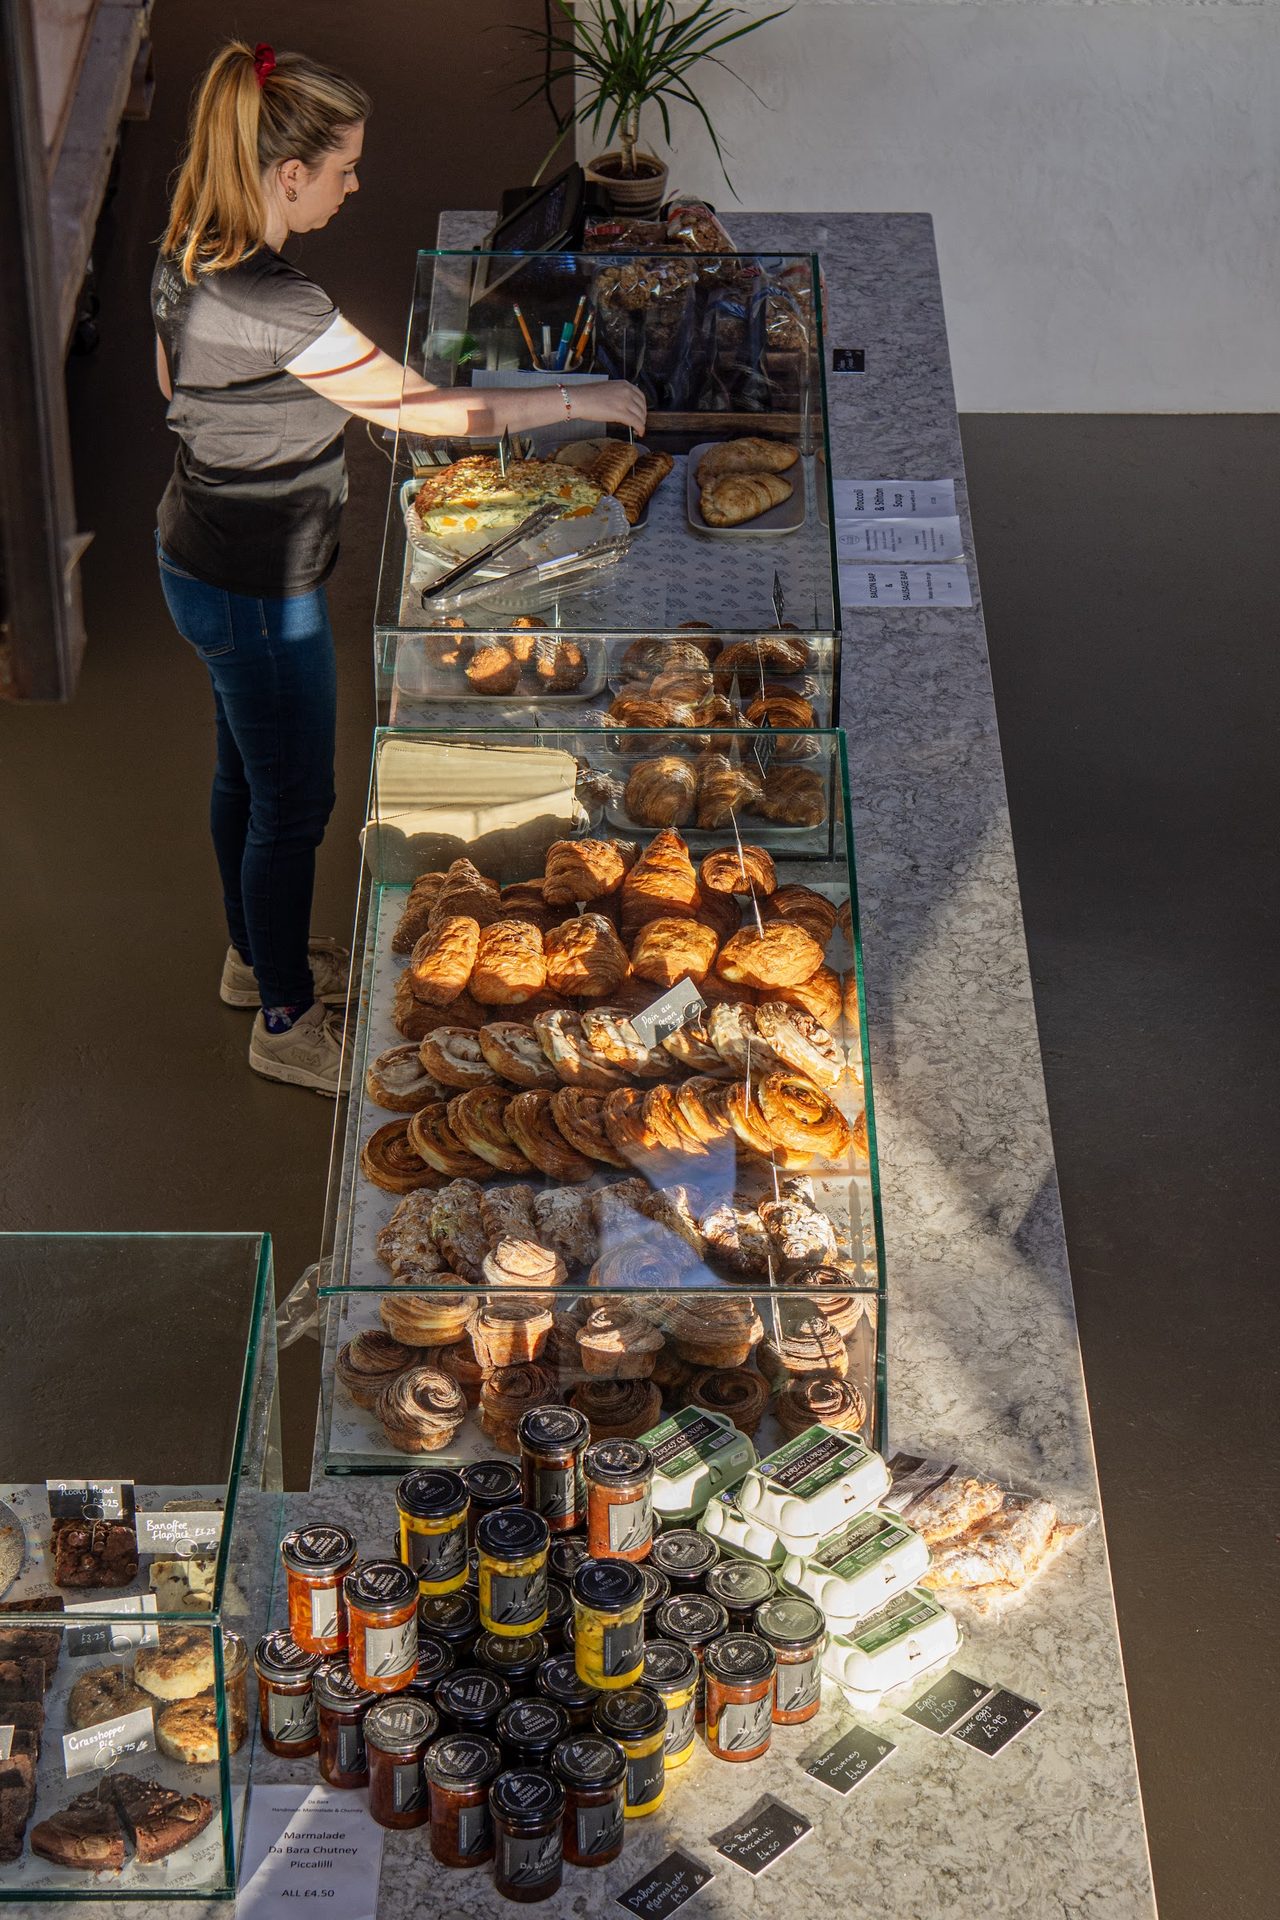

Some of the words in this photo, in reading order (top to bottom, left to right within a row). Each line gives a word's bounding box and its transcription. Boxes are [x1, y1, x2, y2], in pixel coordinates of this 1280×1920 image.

[853, 489, 864, 511] Broccoli
[874, 488, 884, 506] Stilton
[893, 494, 903, 508] Soup
[868, 572, 876, 582] BAP
[900, 570, 908, 580] BAP
[870, 582, 878, 598] BACON
[900, 581, 910, 600] SAUSAGE
[641, 1013, 659, 1028] Pain
[661, 1004, 672, 1013] au
[654, 1440, 677, 1456] URELY
[780, 1458, 807, 1480] PURELY
[806, 1440, 835, 1462] CORNISH
[92, 1484, 115, 1494] Road
[94, 1498, 118, 1508] £3.25
[146, 1520, 188, 1534] Banoffee
[195, 1528, 216, 1536] £3.25
[378, 1574, 392, 1591] ORANGE
[82, 1631, 106, 1644] £3.25
[466, 1685, 474, 1700] SEVILLE
[472, 1684, 480, 1702] ORANGE
[478, 1682, 488, 1706] MARMALADE
[915, 1694, 936, 1712] Eggs
[930, 1699, 957, 1722] £2.50
[522, 1714, 541, 1725] SEVILLE
[524, 1716, 546, 1730] ORANGE
[524, 1718, 554, 1736] MARMALADE
[956, 1721, 976, 1738] Duck
[976, 1705, 992, 1722] eggs
[982, 1714, 1008, 1738] £3.95
[68, 1724, 126, 1750] Grasshopper
[112, 1742, 136, 1756] £3.75
[578, 1750, 593, 1762] SEVILLE
[452, 1751, 466, 1765] SEVILLE
[458, 1751, 472, 1769] ORANGE
[461, 1750, 480, 1774] MARMALADE
[580, 1752, 600, 1768] ORANGE
[583, 1750, 610, 1772] MARMALADE
[808, 1766, 819, 1775] Da
[816, 1752, 836, 1766] Bara
[830, 1750, 860, 1776] Chutney
[844, 1759, 868, 1780] £4.50
[516, 1784, 532, 1797] SEVILLE
[519, 1786, 538, 1802] ORANGE
[520, 1786, 547, 1808] MARMALADE
[284, 1831, 346, 1840] Marmalade
[723, 1843, 738, 1853] Da
[734, 1826, 759, 1842] Bara
[738, 1826, 774, 1855] Piccalilli
[268, 1846, 282, 1854] Da
[286, 1846, 310, 1854] Bara
[313, 1846, 358, 1856] Chutney
[756, 1840, 780, 1860] £4.50
[290, 1860, 332, 1868] Piccalilli
[520, 1862, 532, 1870] DA
[304, 1889, 334, 1898] £4.50
[646, 1871, 686, 1912] Marmalade
